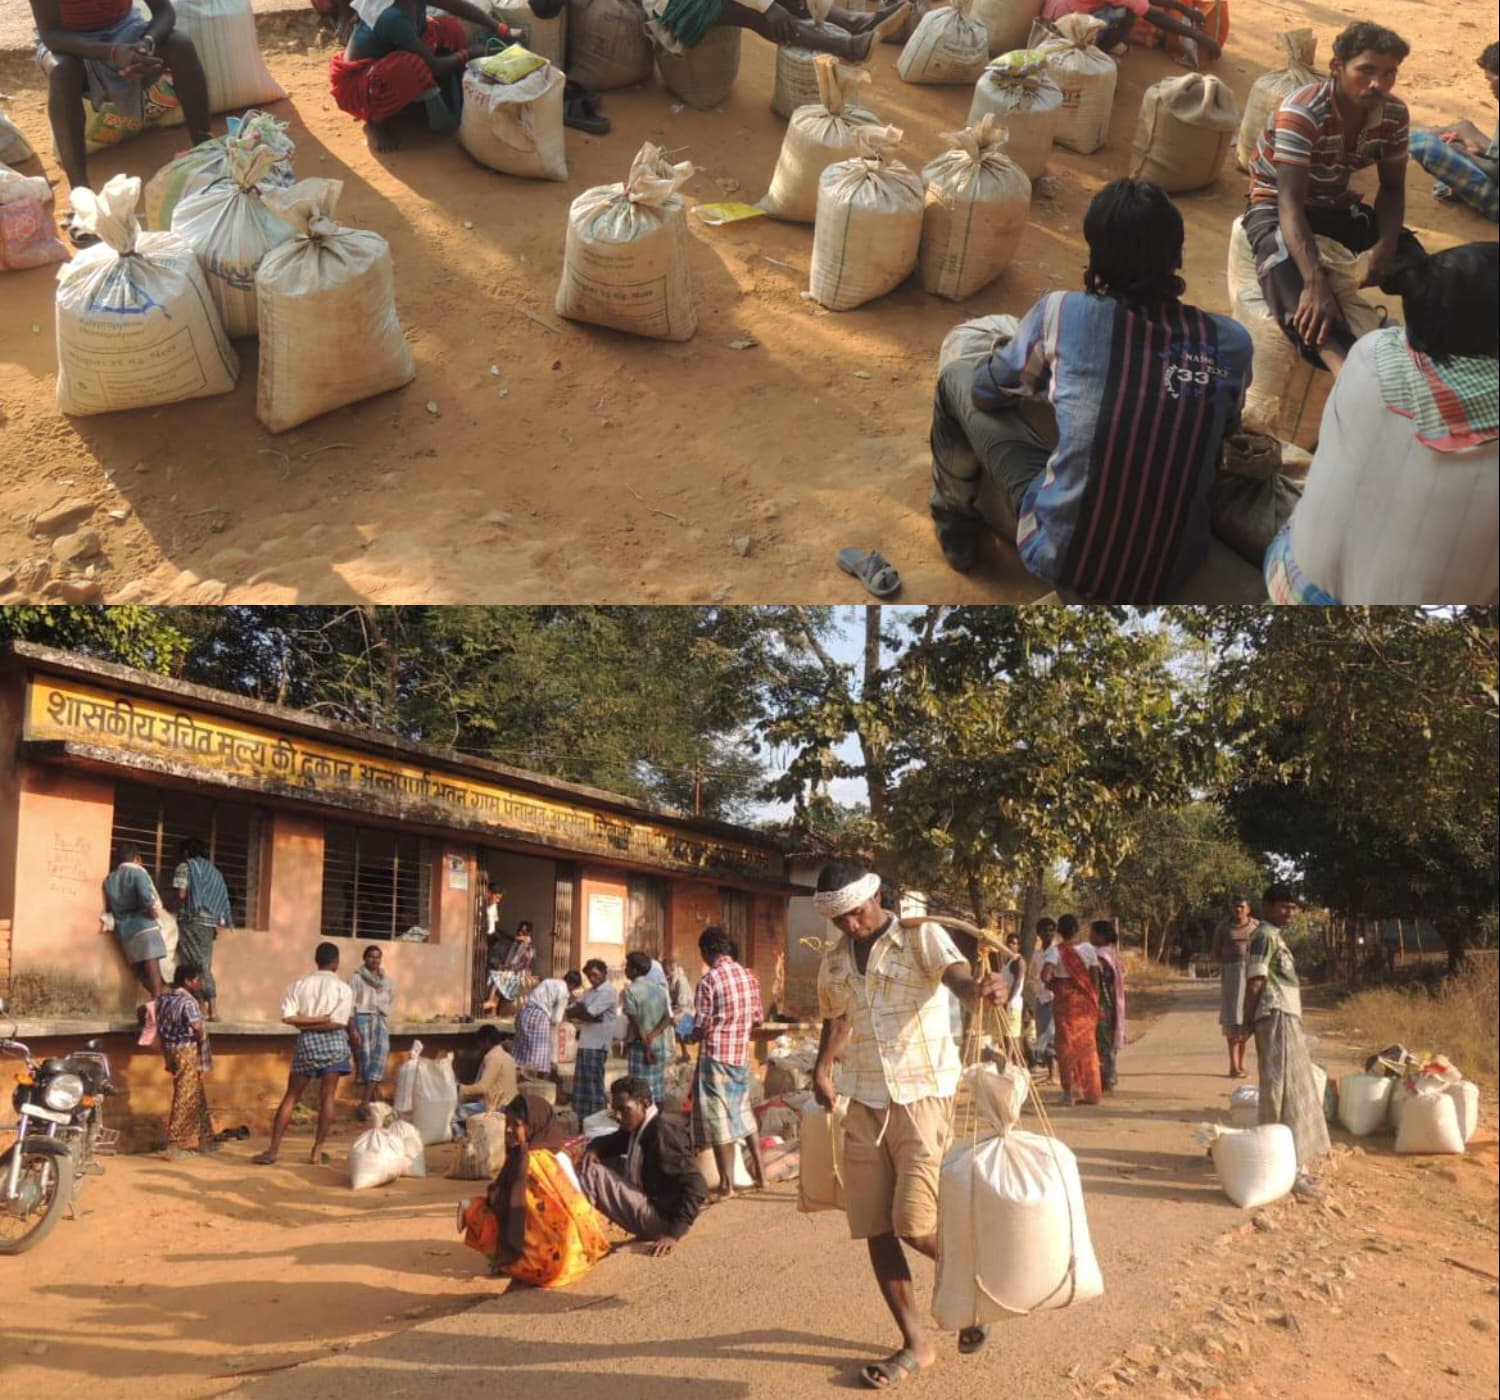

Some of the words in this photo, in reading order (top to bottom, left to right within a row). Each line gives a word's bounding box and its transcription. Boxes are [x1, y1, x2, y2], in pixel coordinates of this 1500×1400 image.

[1178, 368, 1209, 385] 33
[47, 691, 156, 744] शासकीय
[159, 712, 212, 754] उचित
[216, 731, 266, 769] मूल्य
[271, 737, 298, 776] की
